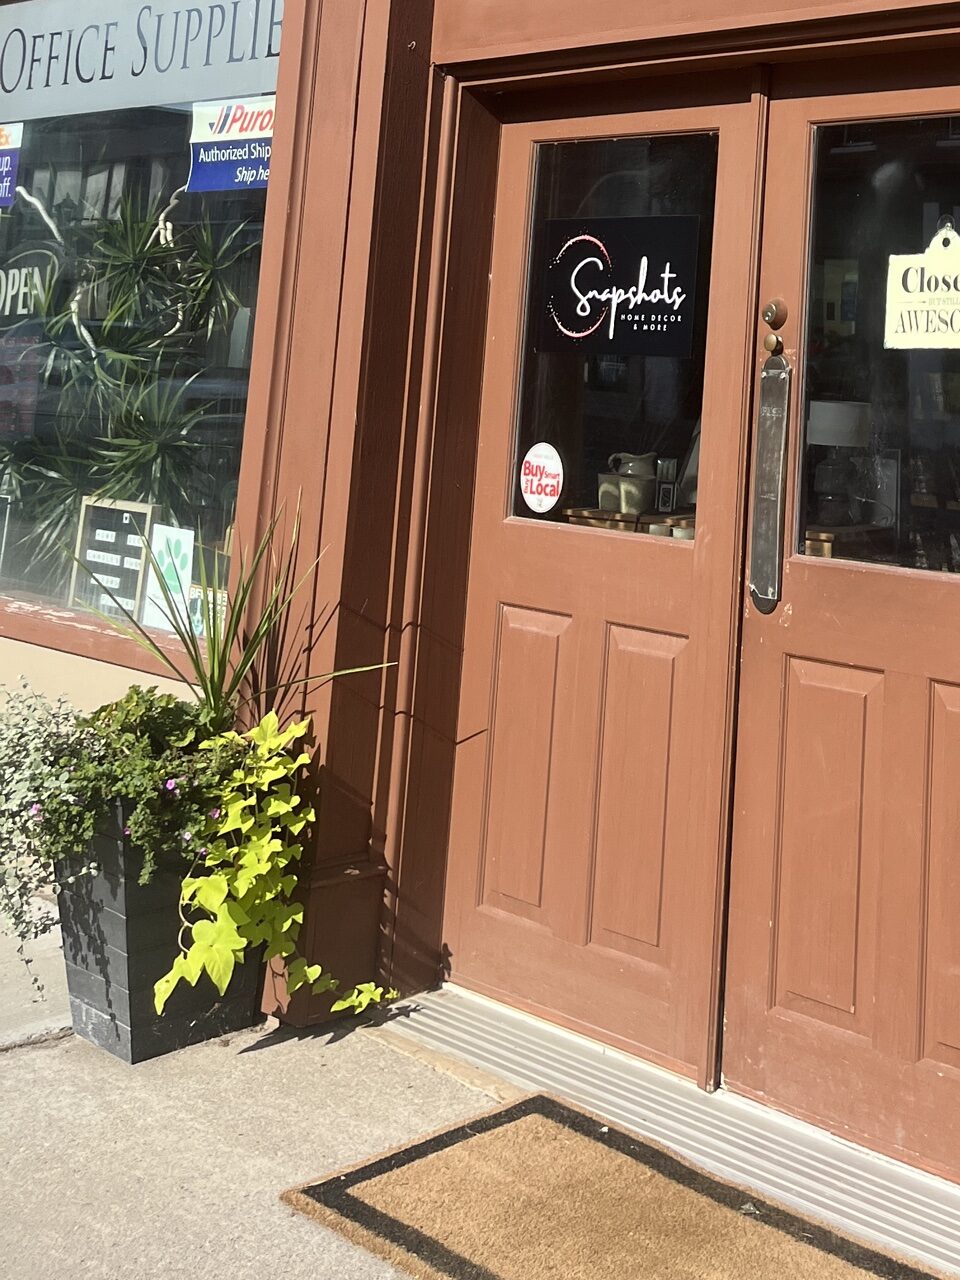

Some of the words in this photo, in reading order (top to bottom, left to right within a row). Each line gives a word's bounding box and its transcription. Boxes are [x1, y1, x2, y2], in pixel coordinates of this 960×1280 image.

[0, 21, 118, 94] OFFICE
[226, 103, 275, 134] Puro
[198, 143, 249, 163] Authorized
[234, 166, 257, 185] Ship
[570, 255, 687, 340] Snapshots
[651, 314, 682, 322] DECOR
[523, 460, 545, 481] Buy
[529, 478, 560, 497] Local
